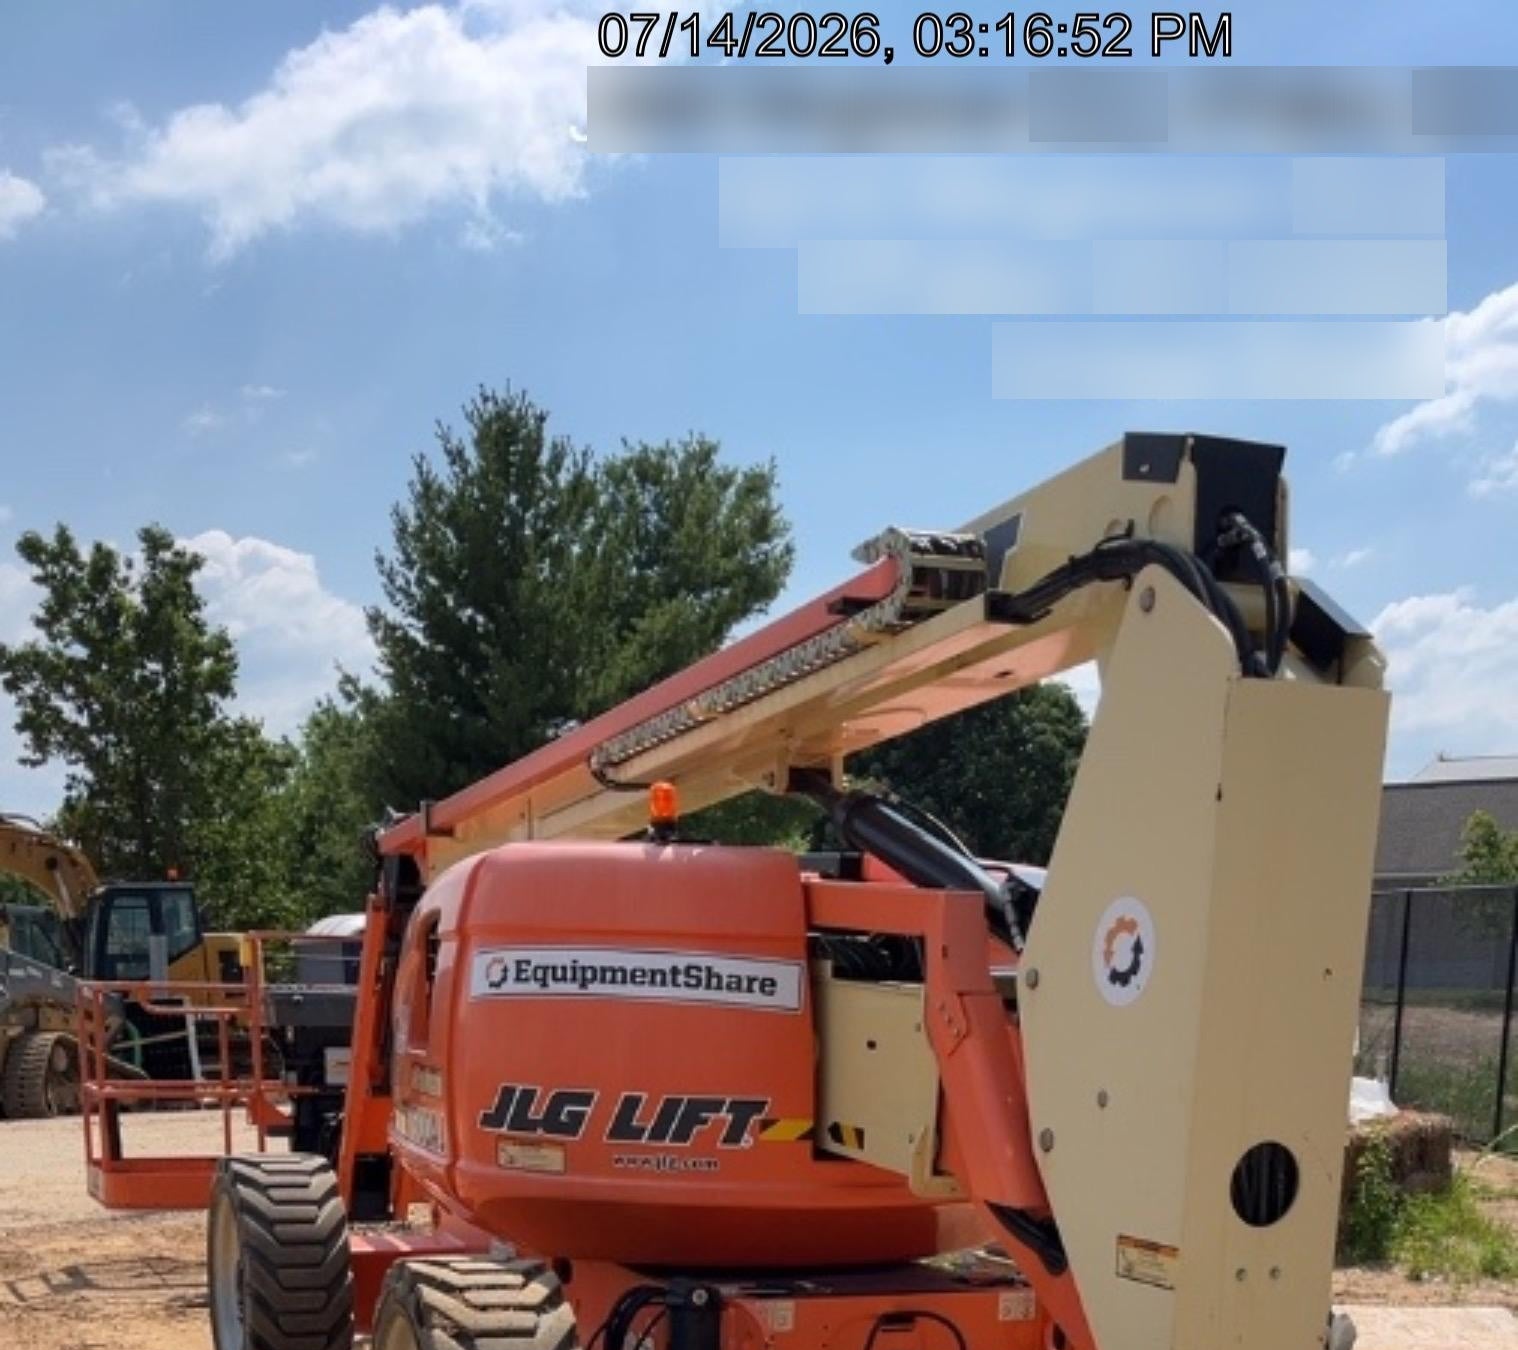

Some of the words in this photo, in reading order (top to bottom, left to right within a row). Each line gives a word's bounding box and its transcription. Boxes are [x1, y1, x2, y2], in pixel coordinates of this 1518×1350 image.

[512, 958, 778, 997] EquipmentShare
[478, 1083, 599, 1141] JLG
[603, 1091, 772, 1149] LIFT
[612, 1154, 720, 1173] www.jlg.com
